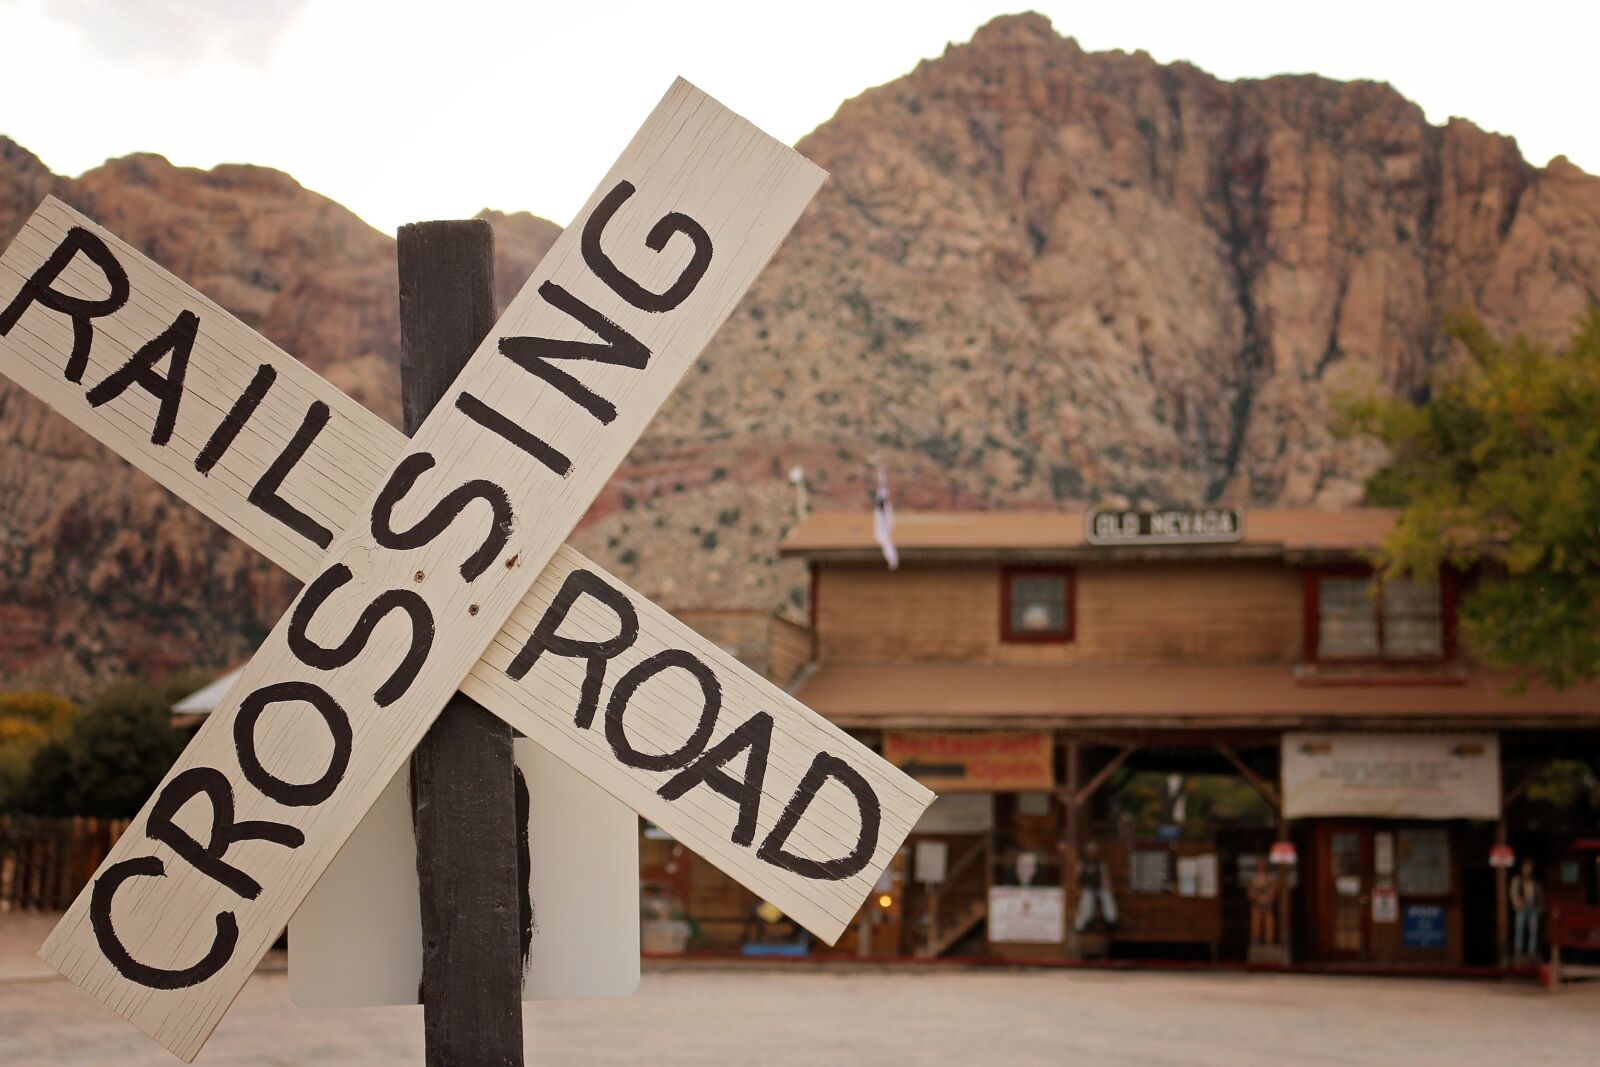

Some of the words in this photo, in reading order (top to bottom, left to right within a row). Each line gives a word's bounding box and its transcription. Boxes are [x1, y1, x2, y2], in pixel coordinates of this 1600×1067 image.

[0, 226, 333, 549] RAIL
[505, 571, 881, 881] ROAD
[90, 180, 713, 990] CROSSING
[1097, 511, 1140, 538] OLD
[1151, 510, 1233, 535] NEVADA
